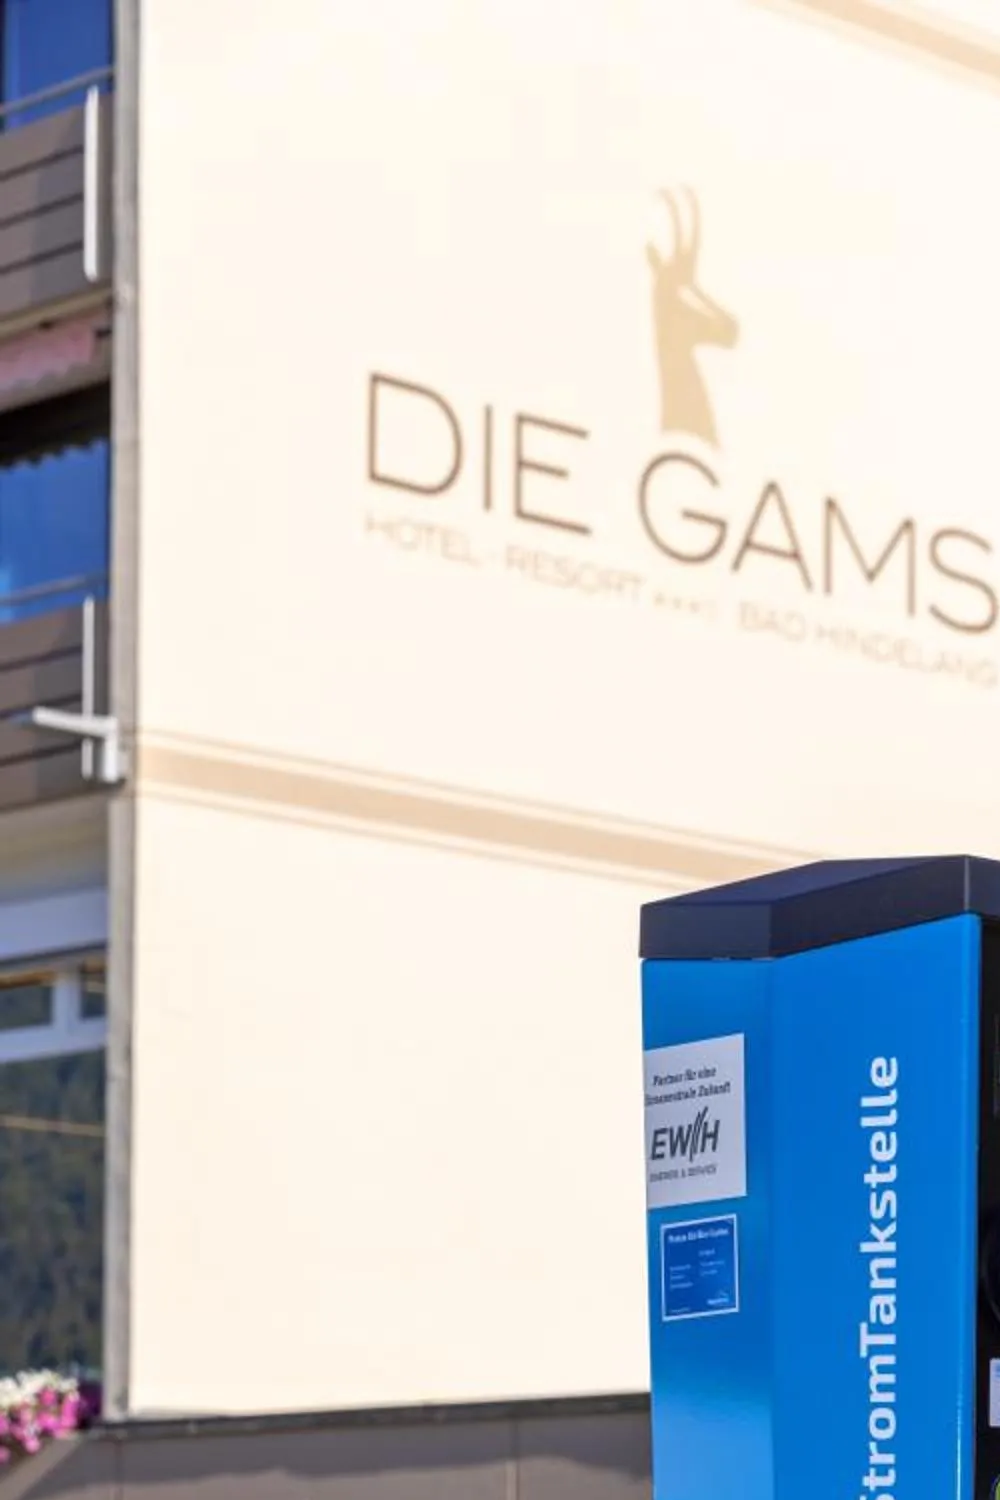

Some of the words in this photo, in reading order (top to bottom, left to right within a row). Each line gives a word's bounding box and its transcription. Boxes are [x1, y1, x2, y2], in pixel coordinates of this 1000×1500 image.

[364, 510, 482, 567] HOTEL
[504, 543, 647, 604] RESORT
[366, 371, 592, 537] DIE
[637, 451, 1000, 635] GAMS
